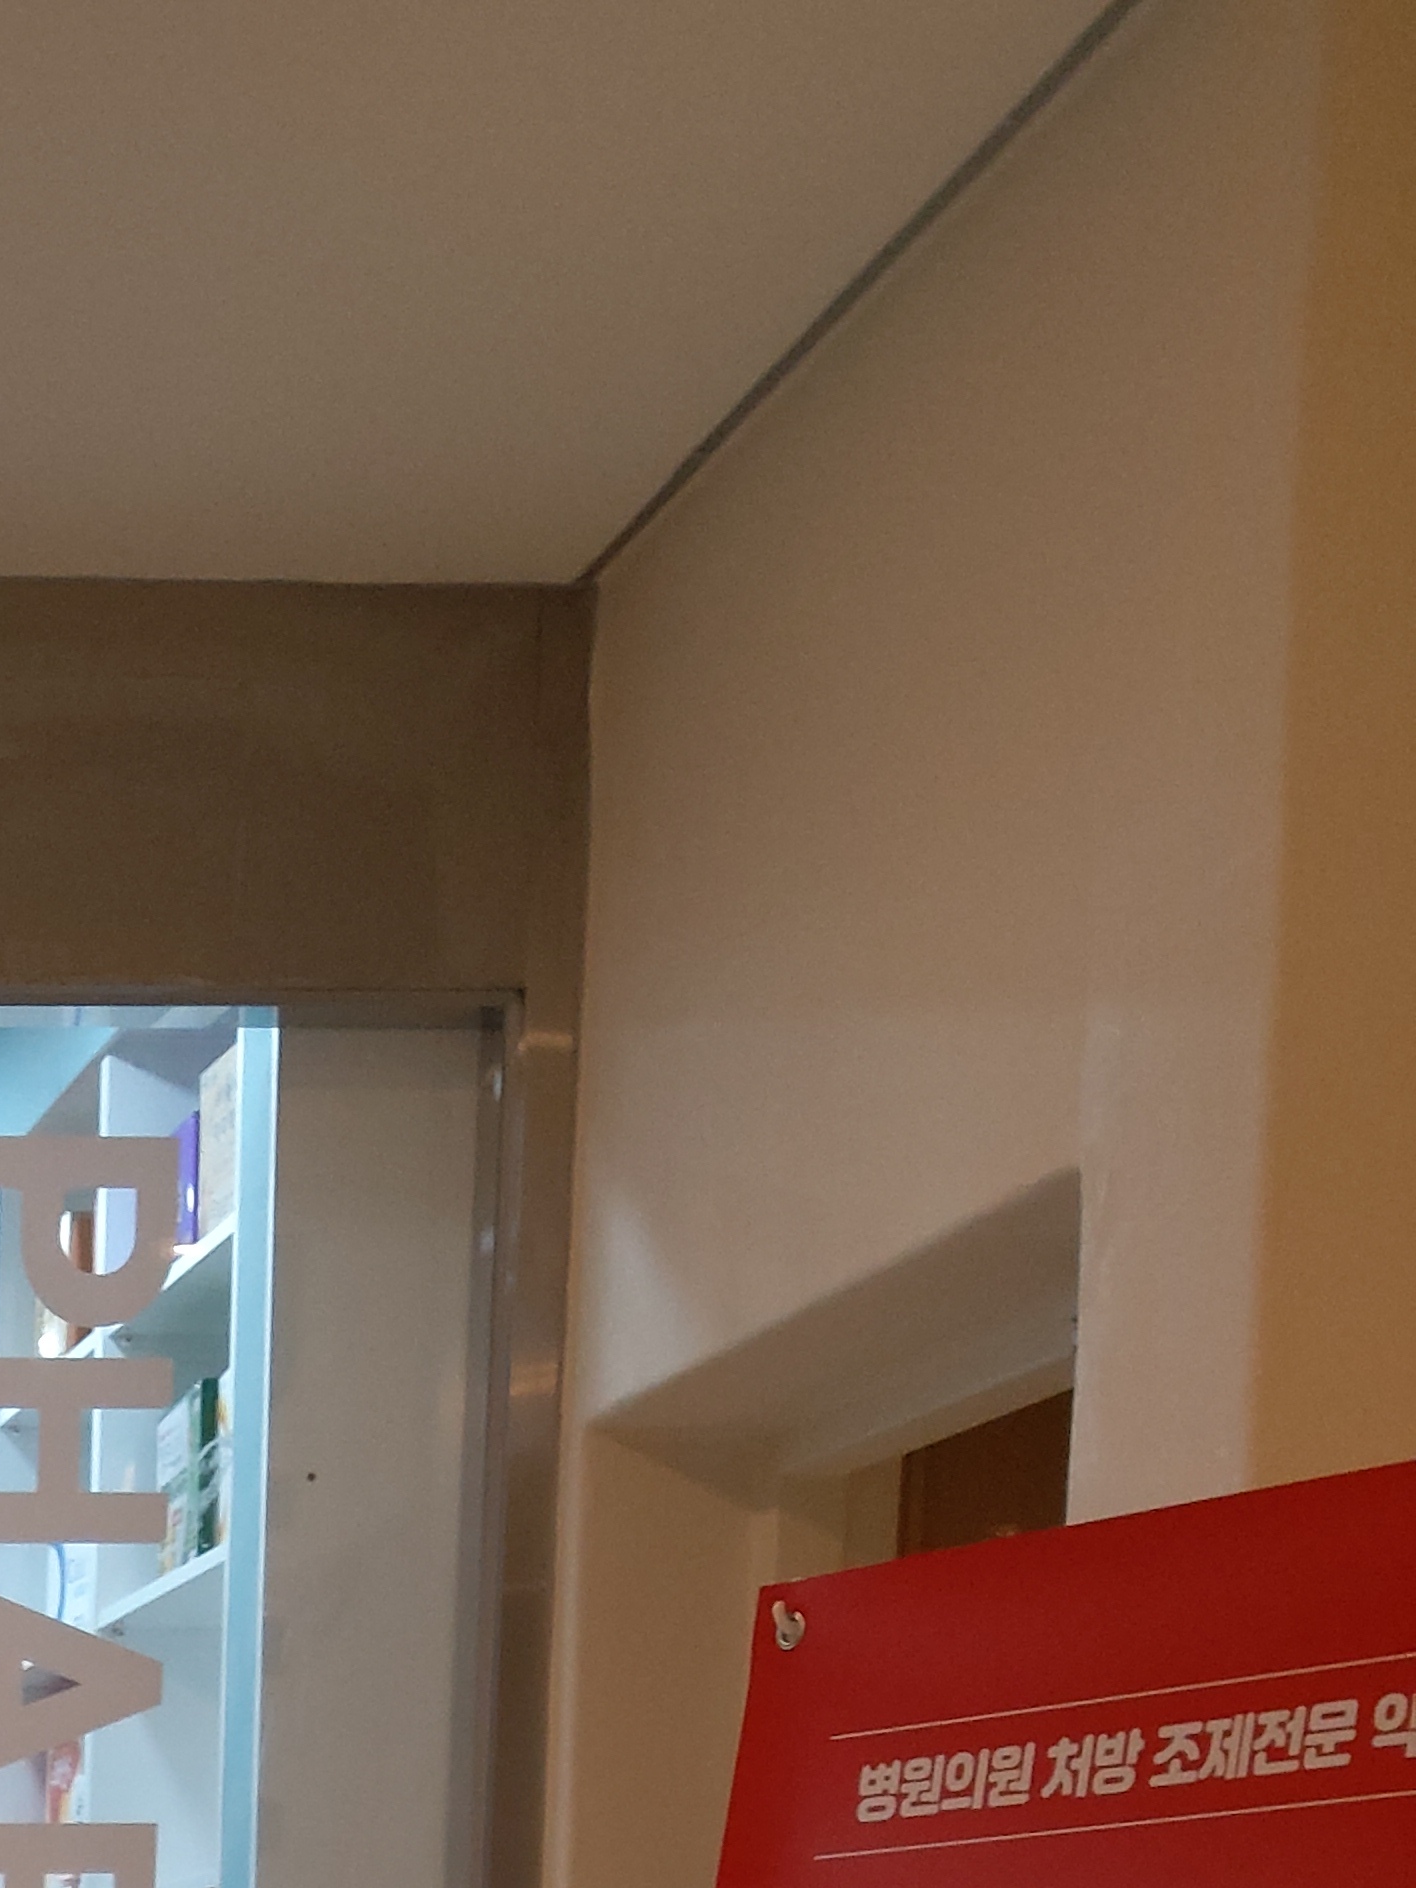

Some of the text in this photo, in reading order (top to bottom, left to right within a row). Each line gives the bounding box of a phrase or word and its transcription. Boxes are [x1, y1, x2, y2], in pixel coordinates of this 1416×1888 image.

[856, 1741, 1035, 1822] 병원의원
[1040, 1728, 1146, 1799] 처방
[1148, 1699, 1358, 1788] 조제전문
